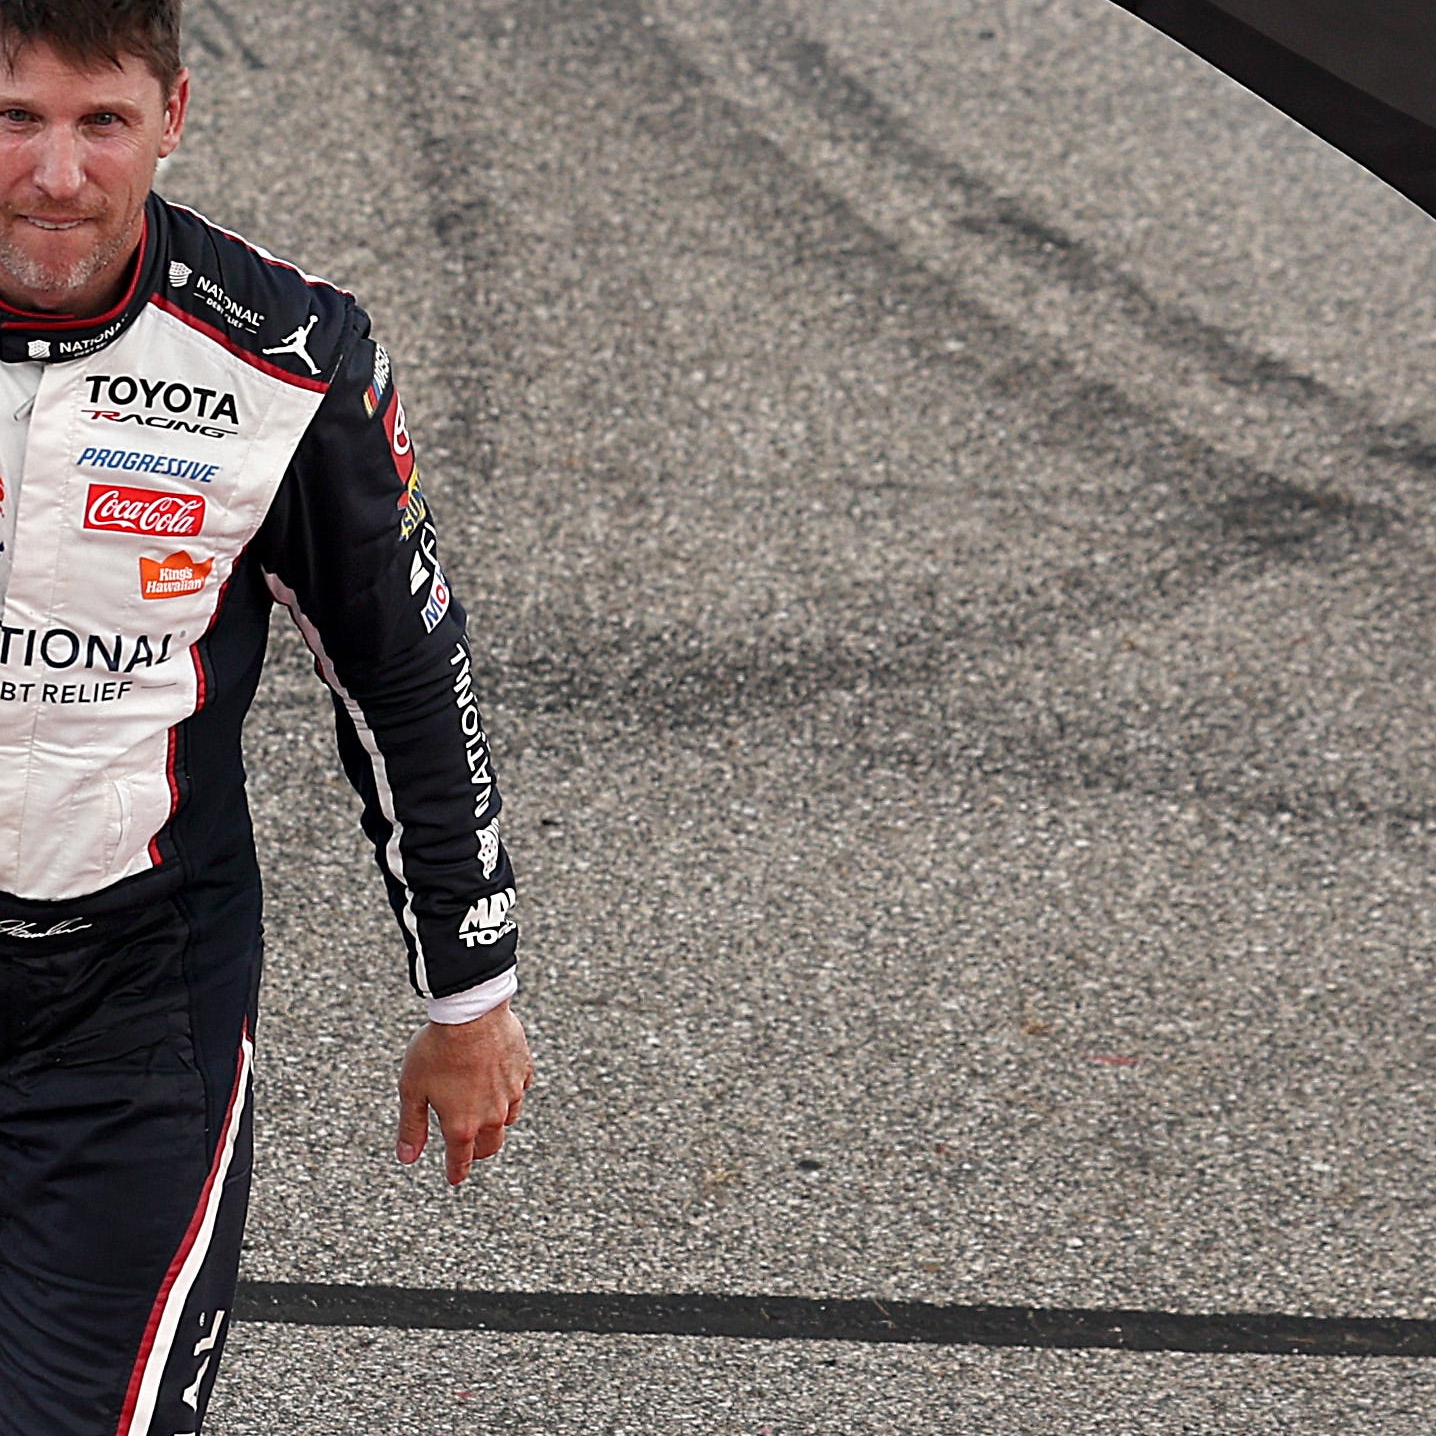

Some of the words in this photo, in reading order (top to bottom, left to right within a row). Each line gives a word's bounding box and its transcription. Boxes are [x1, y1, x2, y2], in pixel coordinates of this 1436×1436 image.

[85, 374, 240, 425] TOYOTA
[81, 409, 239, 439] RACING
[77, 447, 220, 483] PROGRESSIVE
[88, 490, 204, 534] Coca-Cola
[145, 576, 202, 595] Hawaiian
[159, 567, 194, 582] King's
[41, 680, 135, 706] RELIEF
